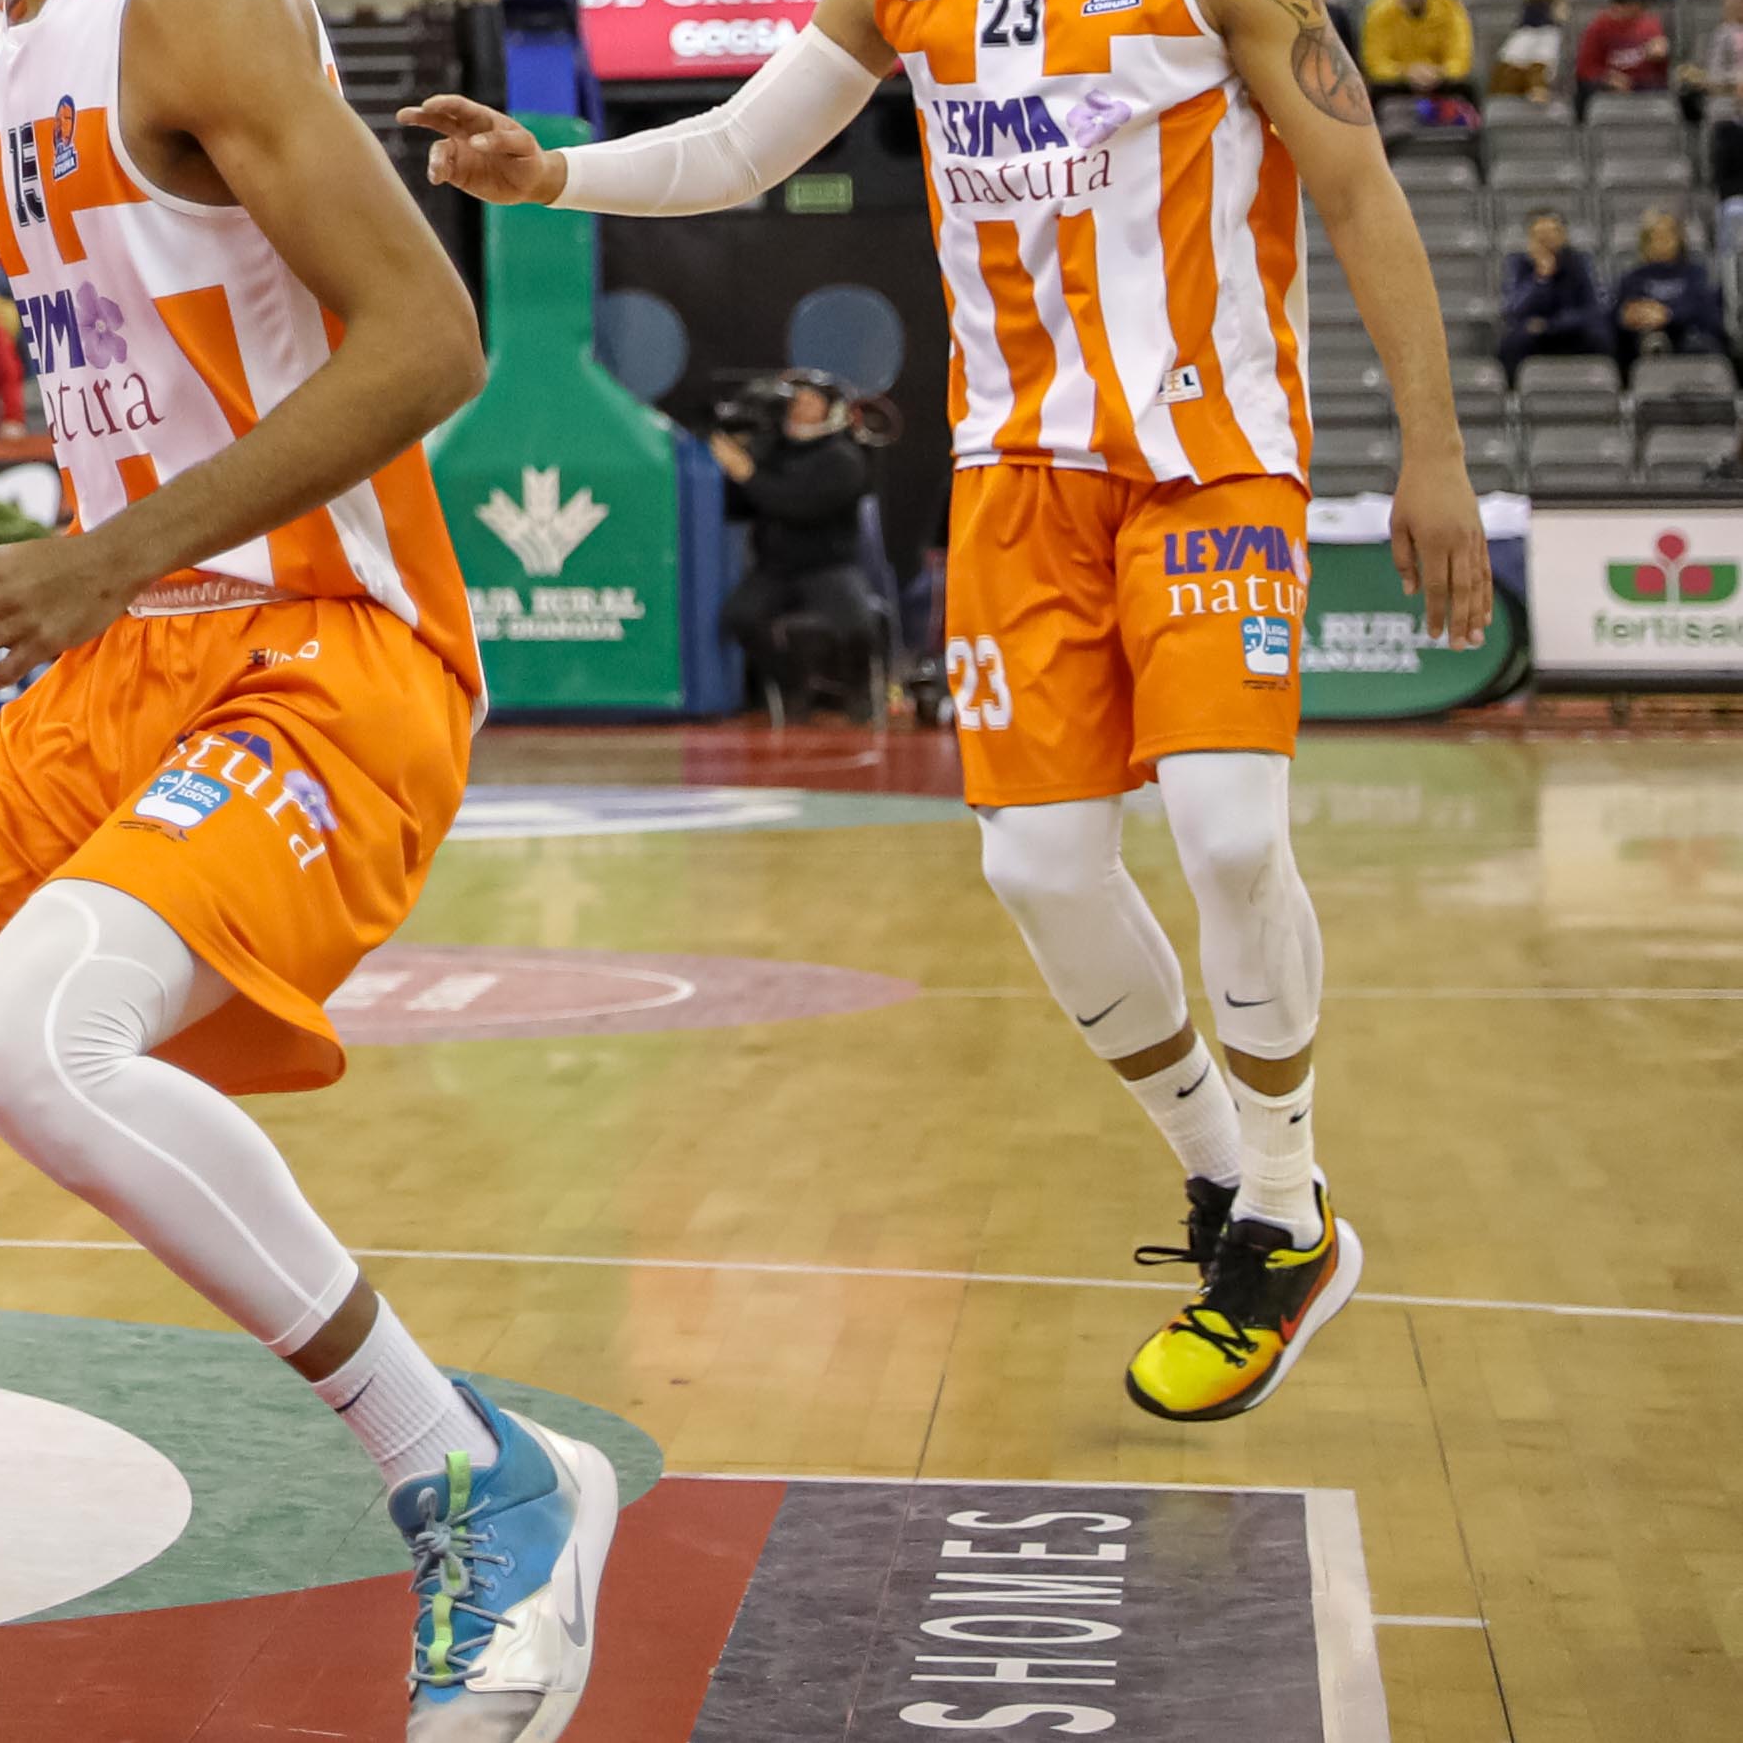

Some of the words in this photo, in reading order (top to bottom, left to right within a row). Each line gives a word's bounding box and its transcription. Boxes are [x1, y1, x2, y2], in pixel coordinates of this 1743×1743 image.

[932, 94, 1070, 158] LEYMA
[944, 148, 1113, 206] natura
[1594, 611, 1743, 648] fertisa
[947, 634, 1013, 731] 23
[899, 1509, 1132, 1735] SHOMES
